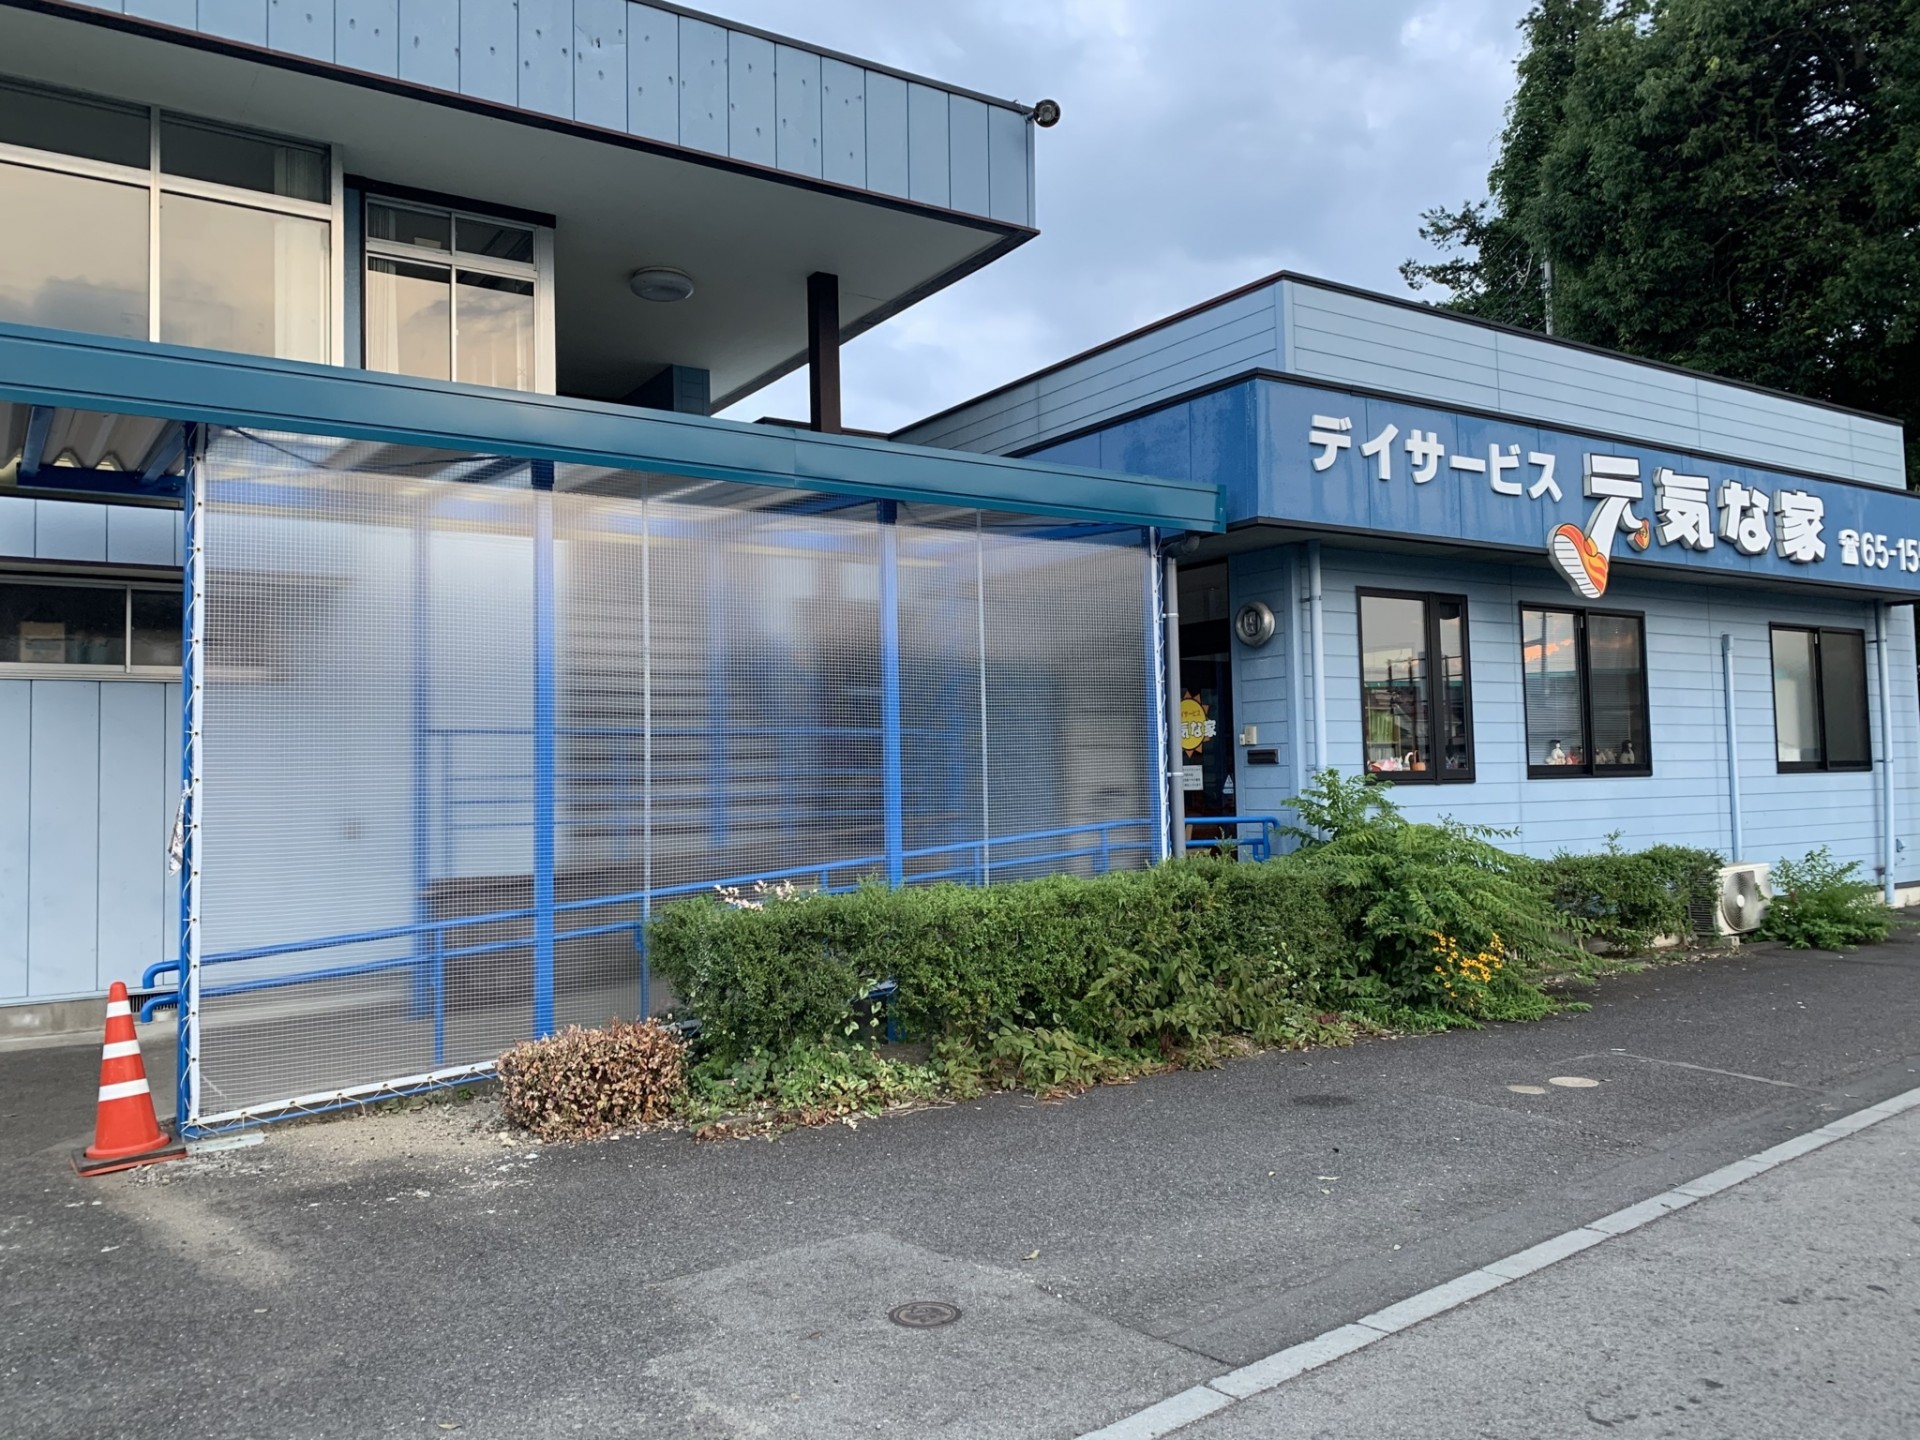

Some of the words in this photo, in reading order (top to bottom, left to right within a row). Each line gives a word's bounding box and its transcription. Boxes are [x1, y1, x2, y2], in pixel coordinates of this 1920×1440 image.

[1309, 414, 1563, 503] デイサービス
[1548, 452, 1827, 598] 元気な家
[1861, 532, 1920, 573] 65-15
